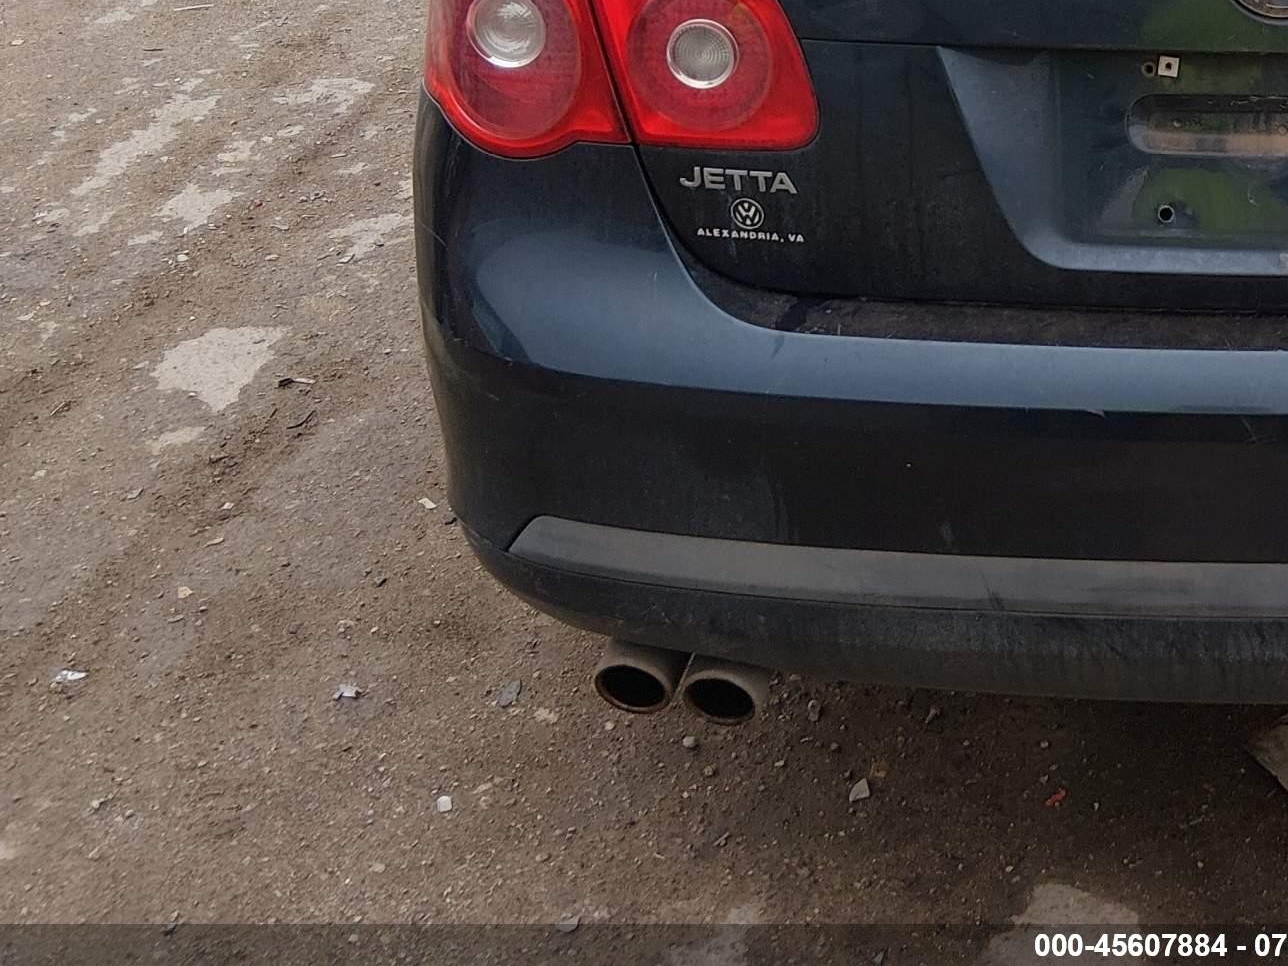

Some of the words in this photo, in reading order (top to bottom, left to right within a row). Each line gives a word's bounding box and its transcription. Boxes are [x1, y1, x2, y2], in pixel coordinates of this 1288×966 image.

[679, 167, 798, 194] JETTA
[696, 227, 785, 243] ALEXANDRIA,
[788, 234, 805, 243] VA
